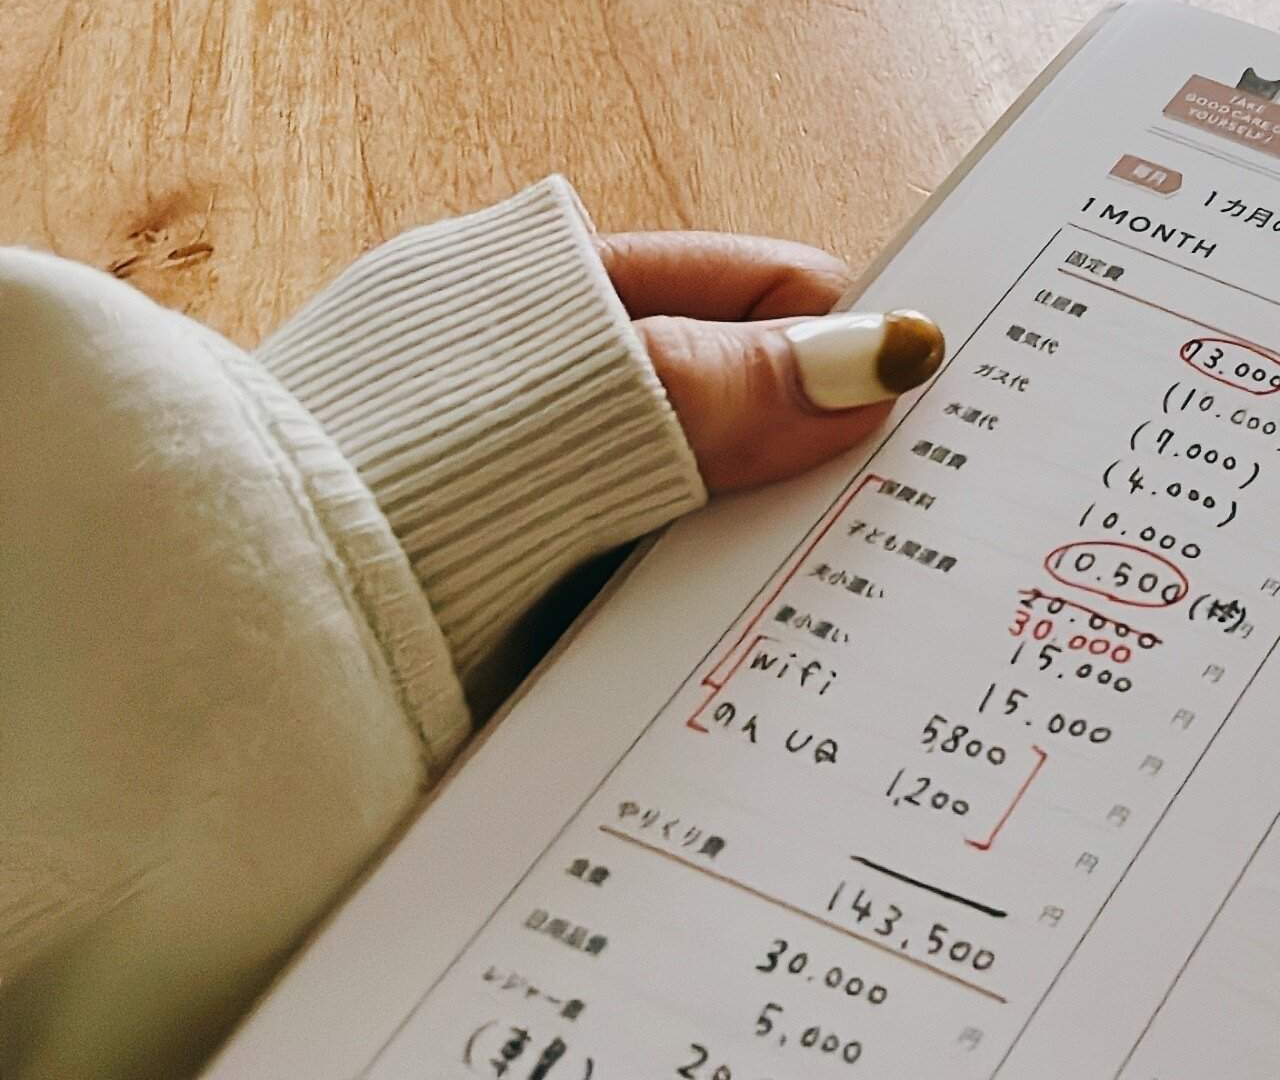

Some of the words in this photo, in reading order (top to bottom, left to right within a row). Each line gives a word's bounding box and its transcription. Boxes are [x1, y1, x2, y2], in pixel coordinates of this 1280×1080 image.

[1185, 92, 1230, 114] GOOD
[1231, 110, 1271, 130] CARE
[1099, 204, 1218, 259] MONTH
[973, 363, 1030, 394] ガス代
[847, 520, 957, 573] 子ども
[808, 563, 884, 599] 夫小い
[617, 801, 726, 859] やりくり
